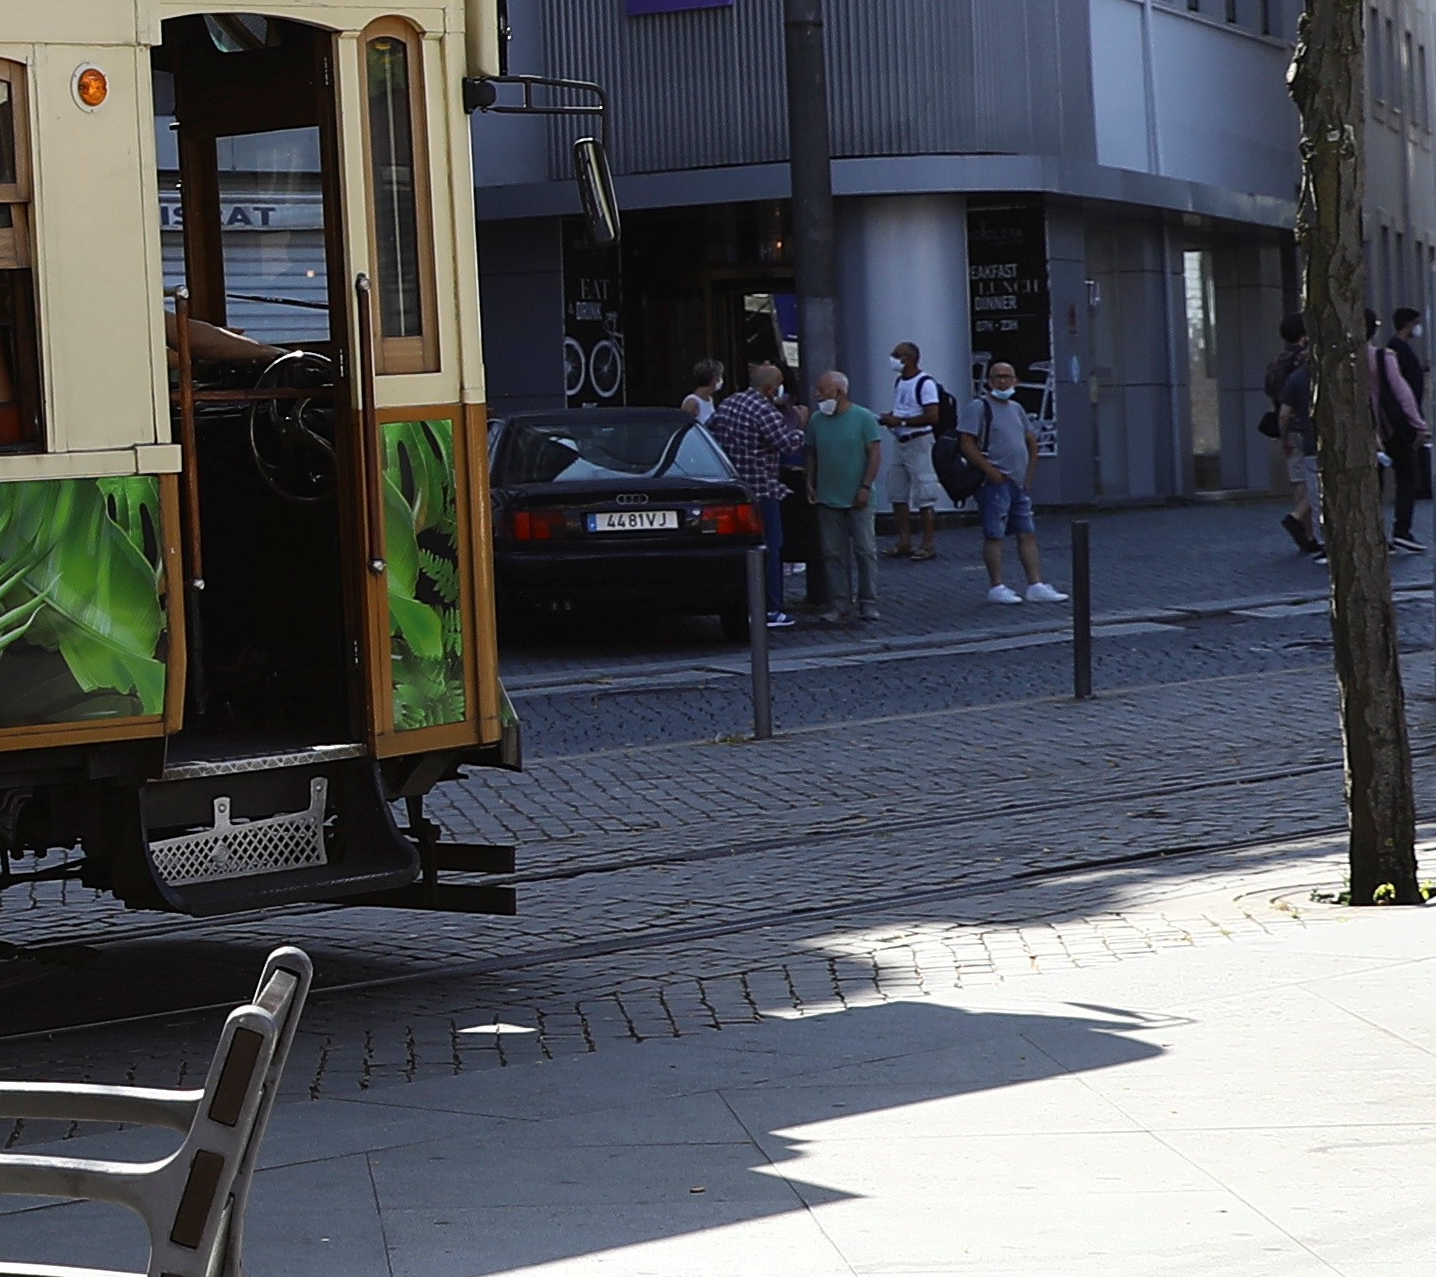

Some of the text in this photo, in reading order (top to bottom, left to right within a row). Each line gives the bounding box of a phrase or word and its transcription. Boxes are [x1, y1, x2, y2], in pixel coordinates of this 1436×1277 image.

[581, 278, 610, 300] EAT
[979, 279, 1039, 294] LUNCH
[975, 295, 1017, 311] DINNER
